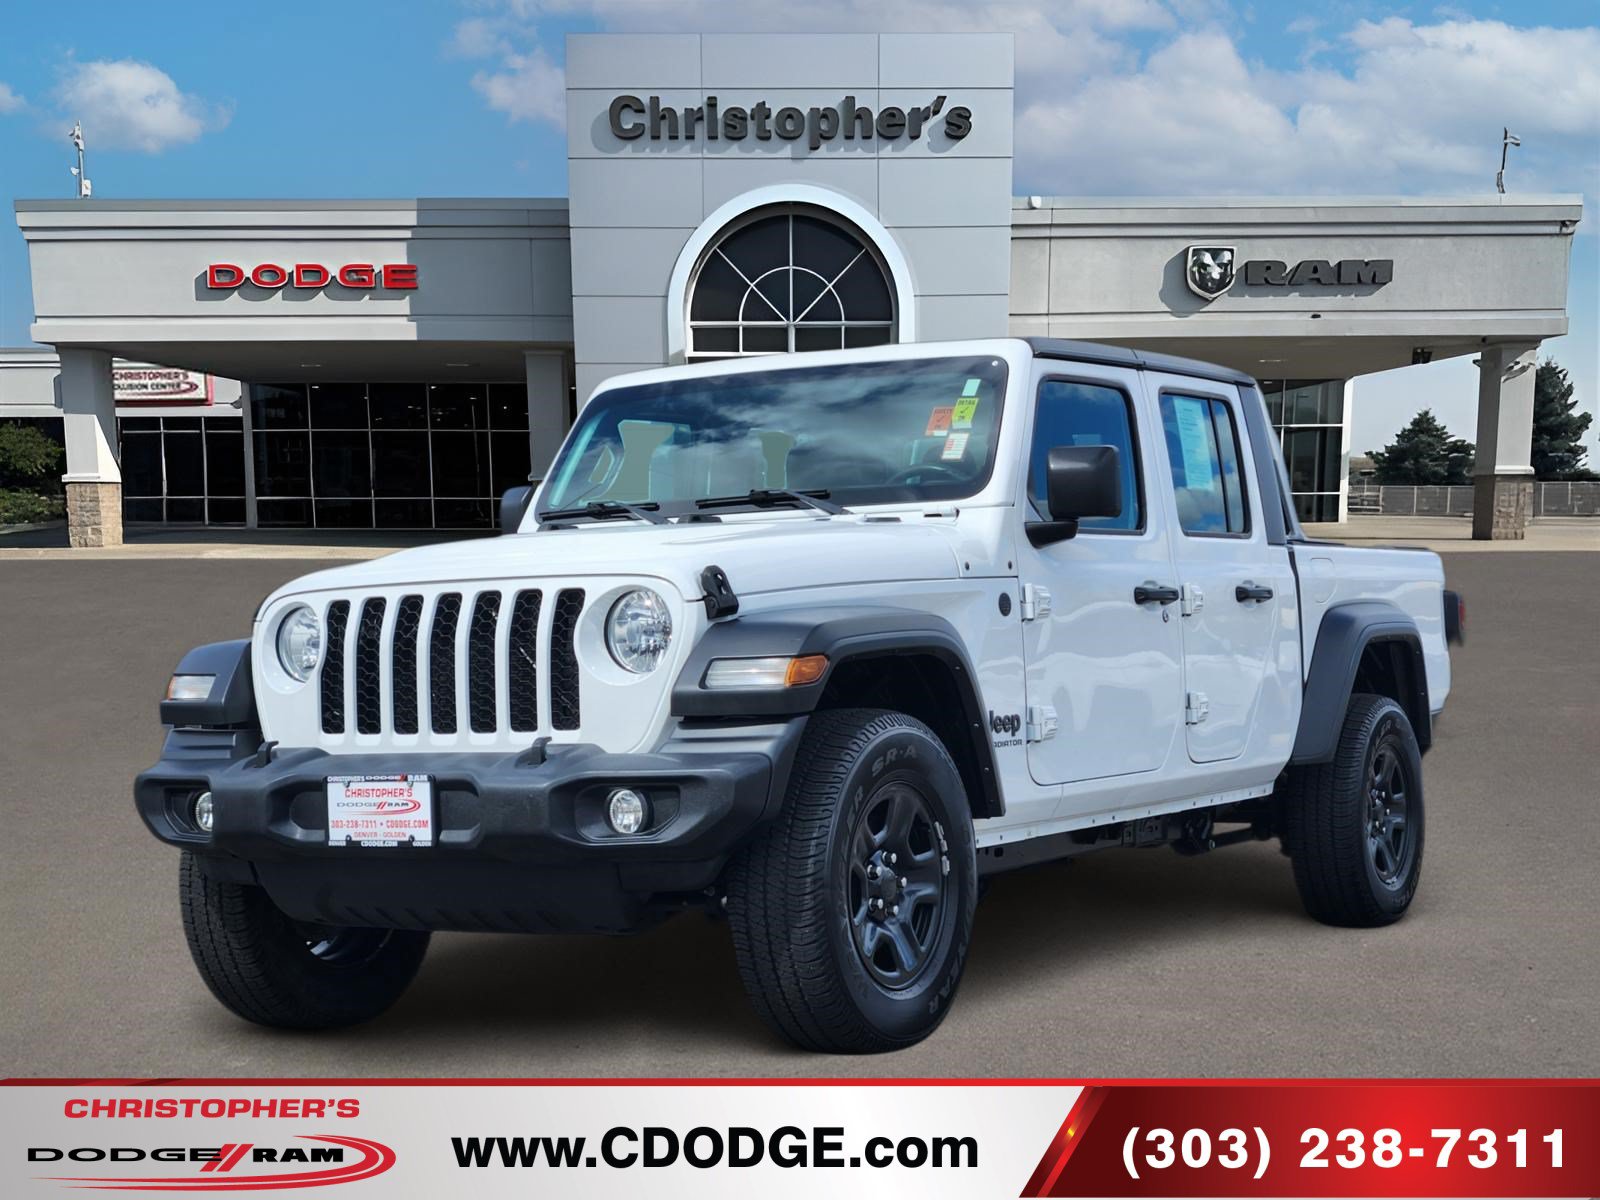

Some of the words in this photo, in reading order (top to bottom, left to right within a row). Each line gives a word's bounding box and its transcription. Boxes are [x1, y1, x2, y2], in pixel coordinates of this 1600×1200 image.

[608, 94, 973, 151] Christopher's
[206, 263, 418, 289] DODGE
[1244, 259, 1394, 286] RAM
[112, 371, 189, 381] CHRISTOPHER'S
[112, 383, 148, 391] OLLISION
[150, 382, 181, 390] CENTER
[344, 788, 413, 798] CHRISTOPHER'S
[331, 819, 377, 829] 303-238-7311
[386, 819, 429, 829] CDODGE.COM
